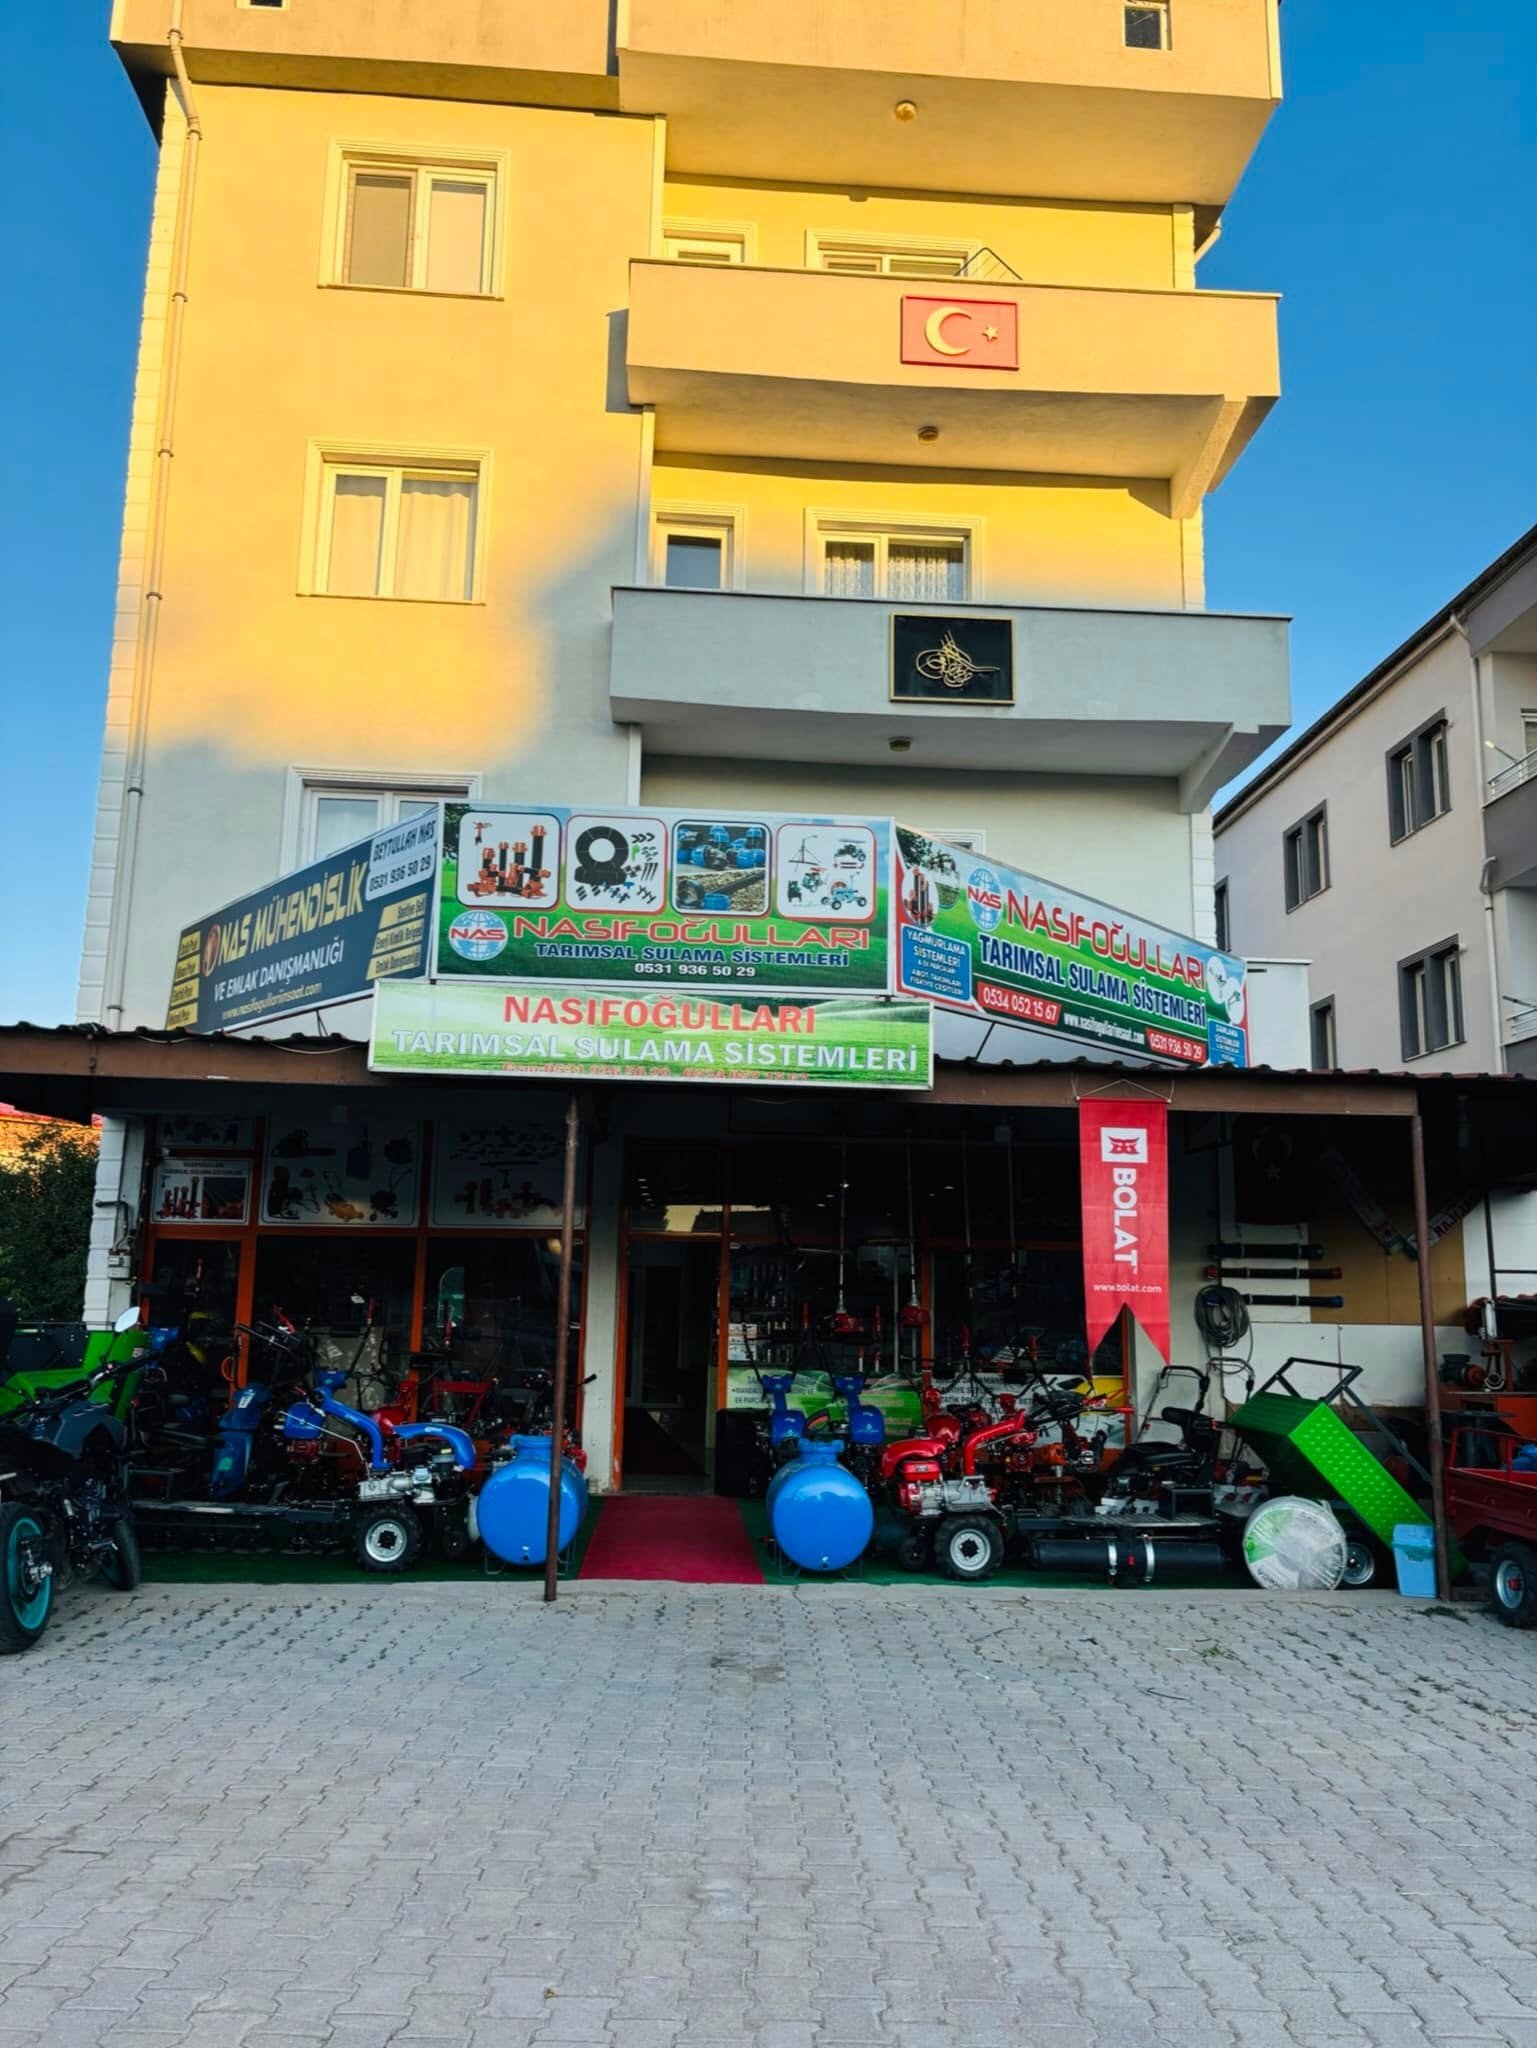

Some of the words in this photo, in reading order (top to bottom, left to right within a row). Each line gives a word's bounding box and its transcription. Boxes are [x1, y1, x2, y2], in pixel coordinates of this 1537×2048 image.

[373, 827, 418, 862] BEYTULLAH
[418, 820, 436, 844] NAS
[369, 871, 388, 892] 0531
[390, 865, 406, 884] 936
[408, 860, 418, 877] 50
[420, 855, 431, 872] 29
[218, 913, 253, 967] NAS
[251, 860, 369, 953] MÜHENDİSLİK
[967, 885, 1001, 910] NAS
[451, 928, 506, 941] NAS
[514, 916, 869, 949] NASIFOĞULLARI
[1007, 888, 1207, 991] NASIFOĞULLARI
[214, 981, 227, 1001] VE
[226, 968, 260, 999] EMLAK
[259, 935, 345, 985] DANIŞMANLIĞI
[536, 943, 637, 960] TARIMSAL
[643, 947, 725, 963] SULAMA
[732, 947, 848, 966] SİSTEMLERİ
[634, 963, 671, 974] 0531
[679, 964, 707, 975] 936
[712, 966, 732, 976] 50
[736, 967, 756, 977] 29
[979, 934, 1065, 985] TARIMSAL
[1068, 962, 1130, 1005] SULAMA
[1133, 977, 1206, 1026] SİSTEMLERİ
[504, 995, 815, 1033] NASIFOĞULLARI
[983, 987, 1009, 1009] 0534
[1011, 995, 1031, 1014] 052
[1033, 1001, 1043, 1017] 15
[1045, 1005, 1057, 1021] 67
[393, 1029, 567, 1058] TARIMSAL
[574, 1036, 714, 1064] SULAMA
[725, 1038, 917, 1072] SİSTEMLERİ
[1150, 1033, 1168, 1050] 0531
[1168, 1038, 1181, 1054] 936
[1183, 1041, 1192, 1057] 50
[1193, 1044, 1202, 1059] 29
[1112, 1168, 1137, 1267] BOLAT
[1093, 1283, 1162, 1294] www.bolat.com
